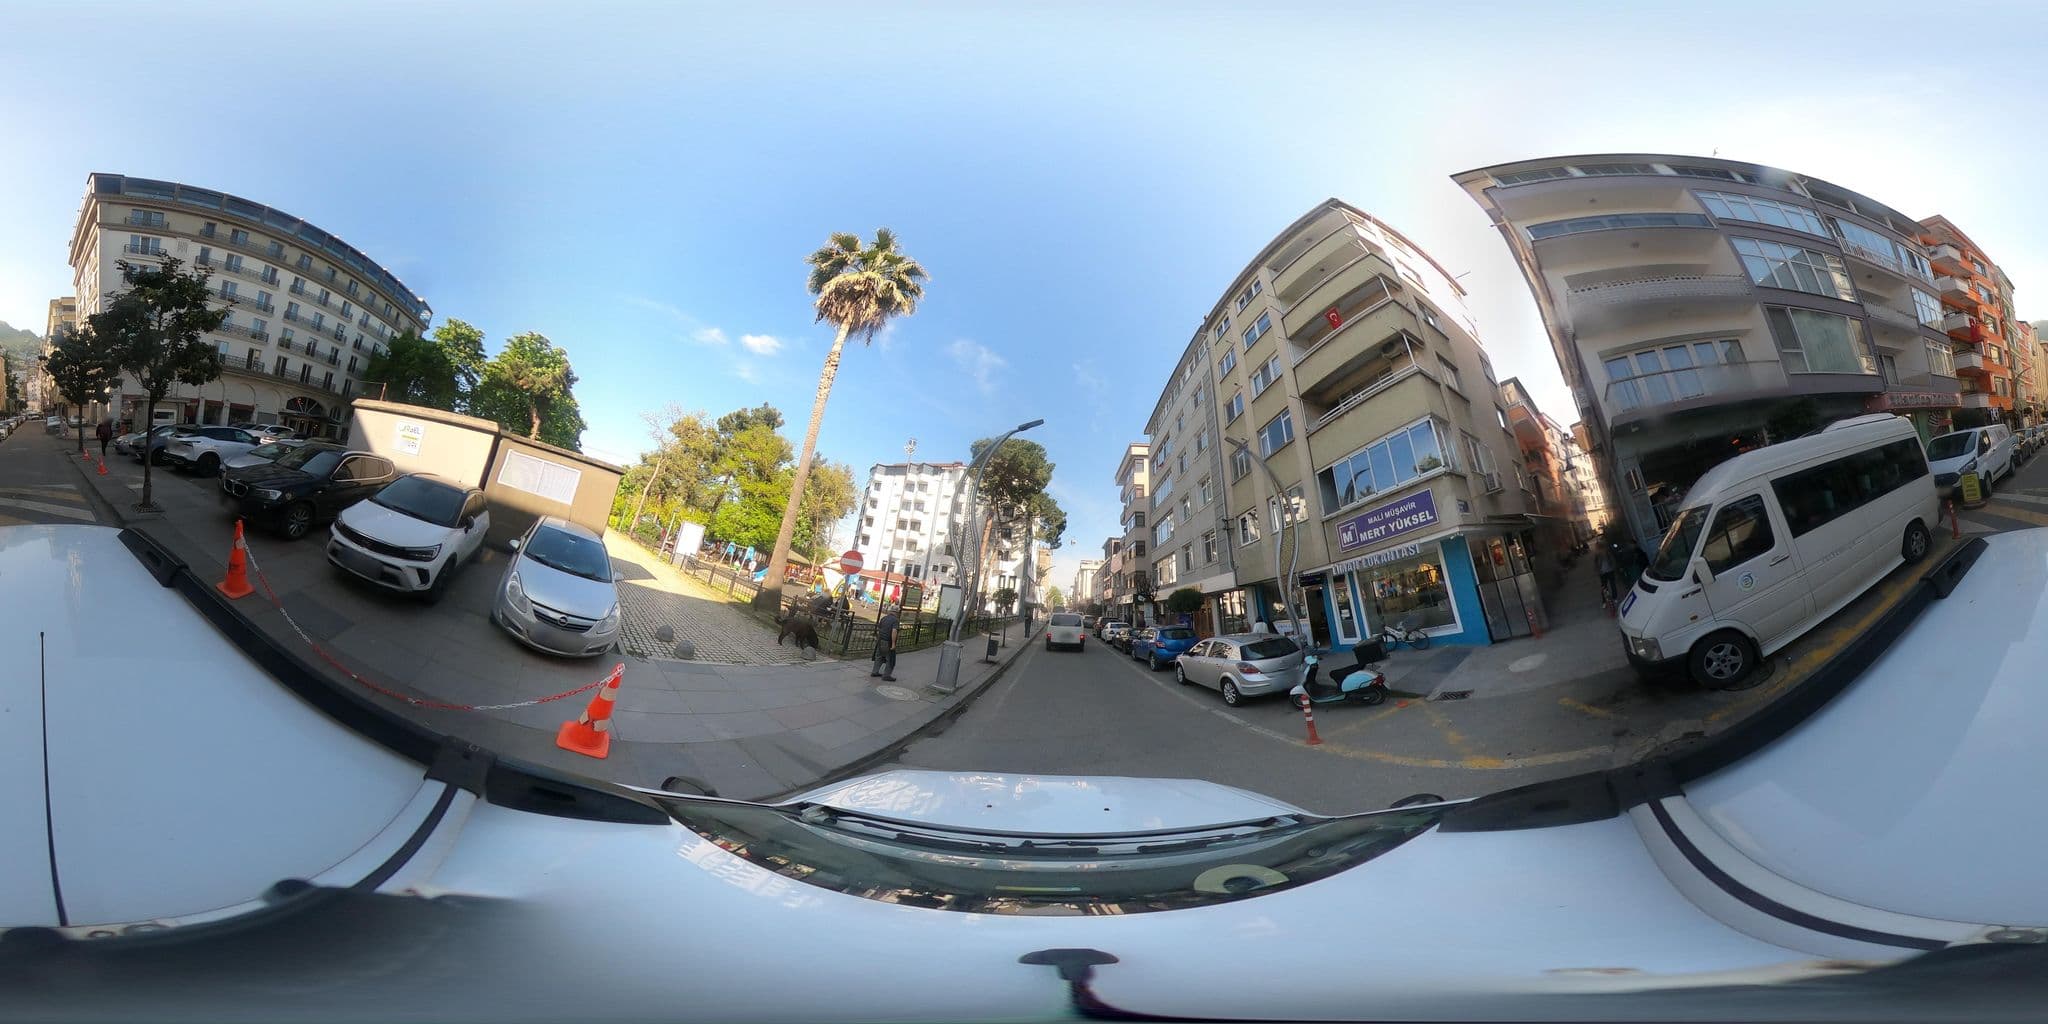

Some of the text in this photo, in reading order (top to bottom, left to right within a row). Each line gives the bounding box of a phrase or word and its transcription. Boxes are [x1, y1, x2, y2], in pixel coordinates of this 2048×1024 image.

[1360, 510, 1434, 542] MERT YÜKSEL
[1367, 502, 1417, 525] MALİ MÜŞAVİR
